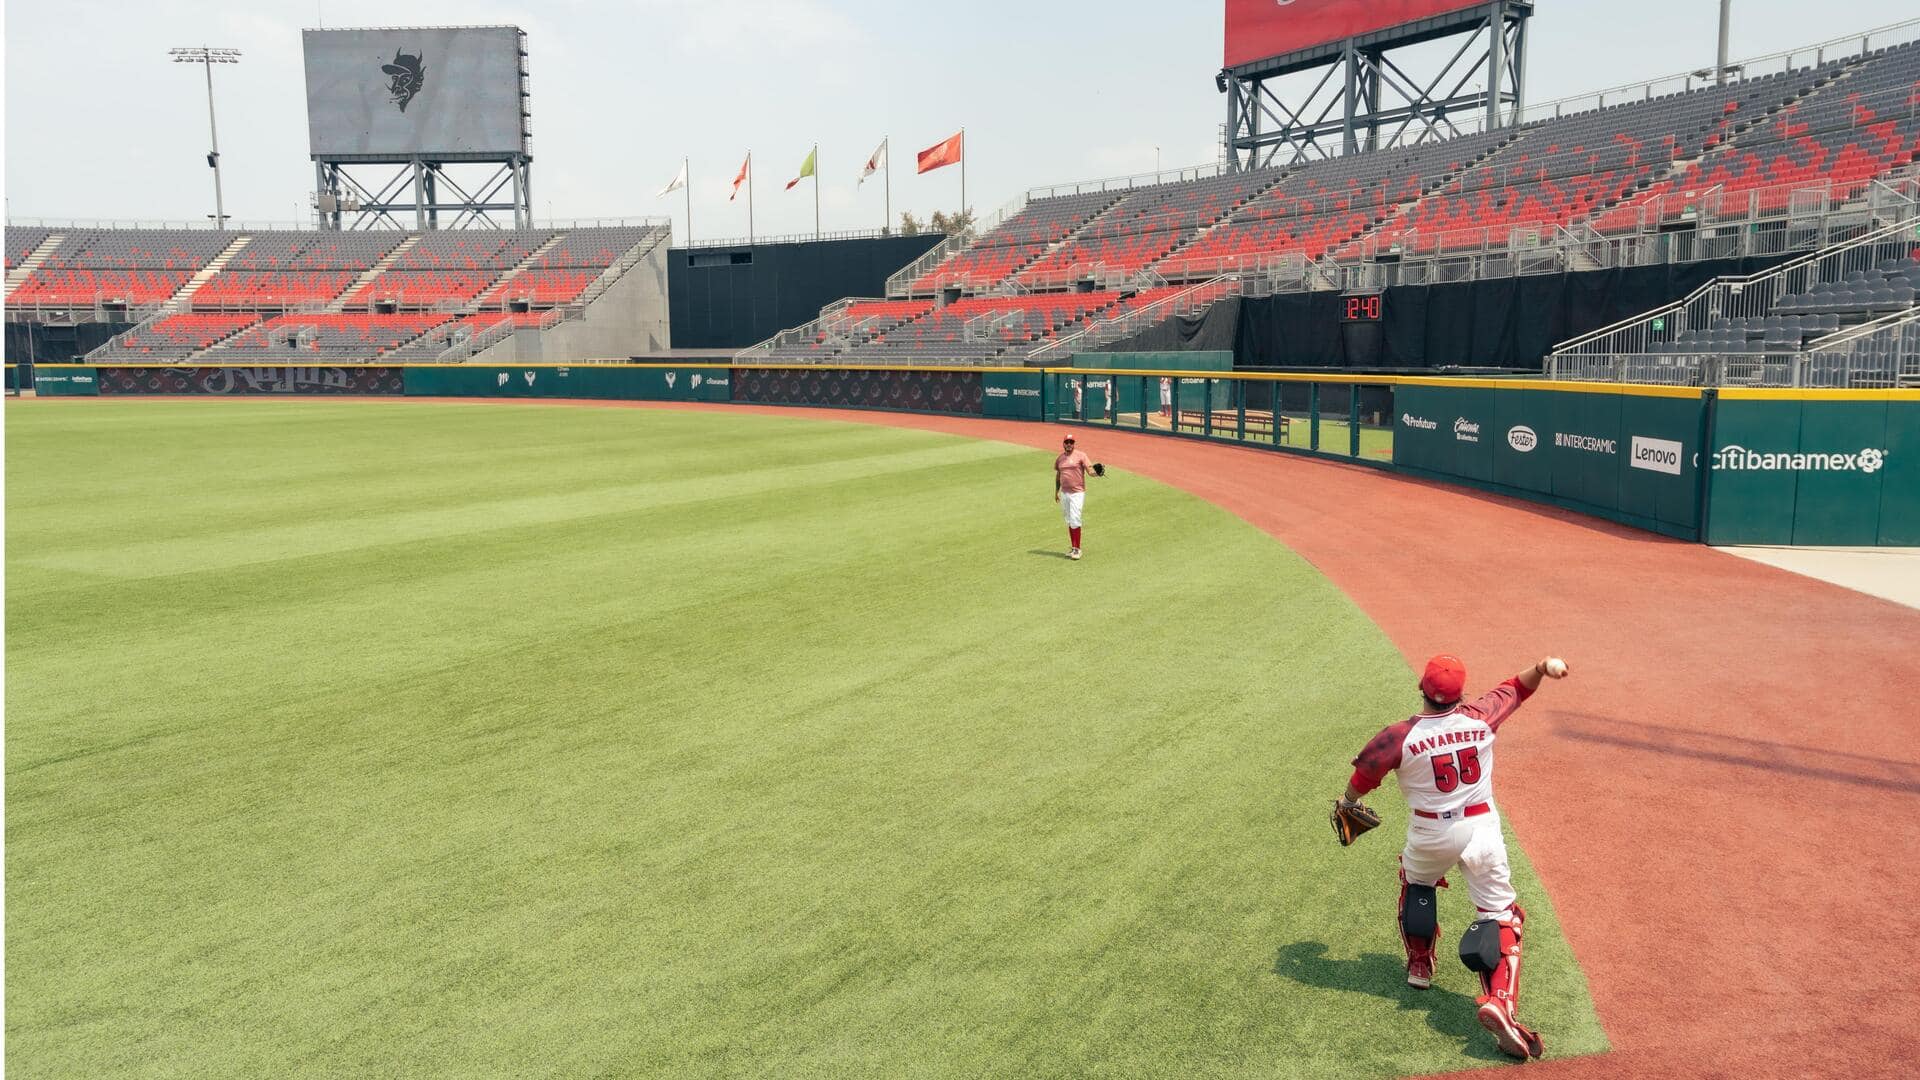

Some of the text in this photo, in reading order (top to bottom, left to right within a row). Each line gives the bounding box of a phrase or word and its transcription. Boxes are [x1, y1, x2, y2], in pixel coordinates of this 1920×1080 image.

[1510, 430, 1534, 447] Fester
[1563, 433, 1617, 454] INTERCERAMIC
[1635, 442, 1677, 466] Lenovo
[1408, 730, 1486, 757] NAVARRETE
[1431, 745, 1481, 793] 55
